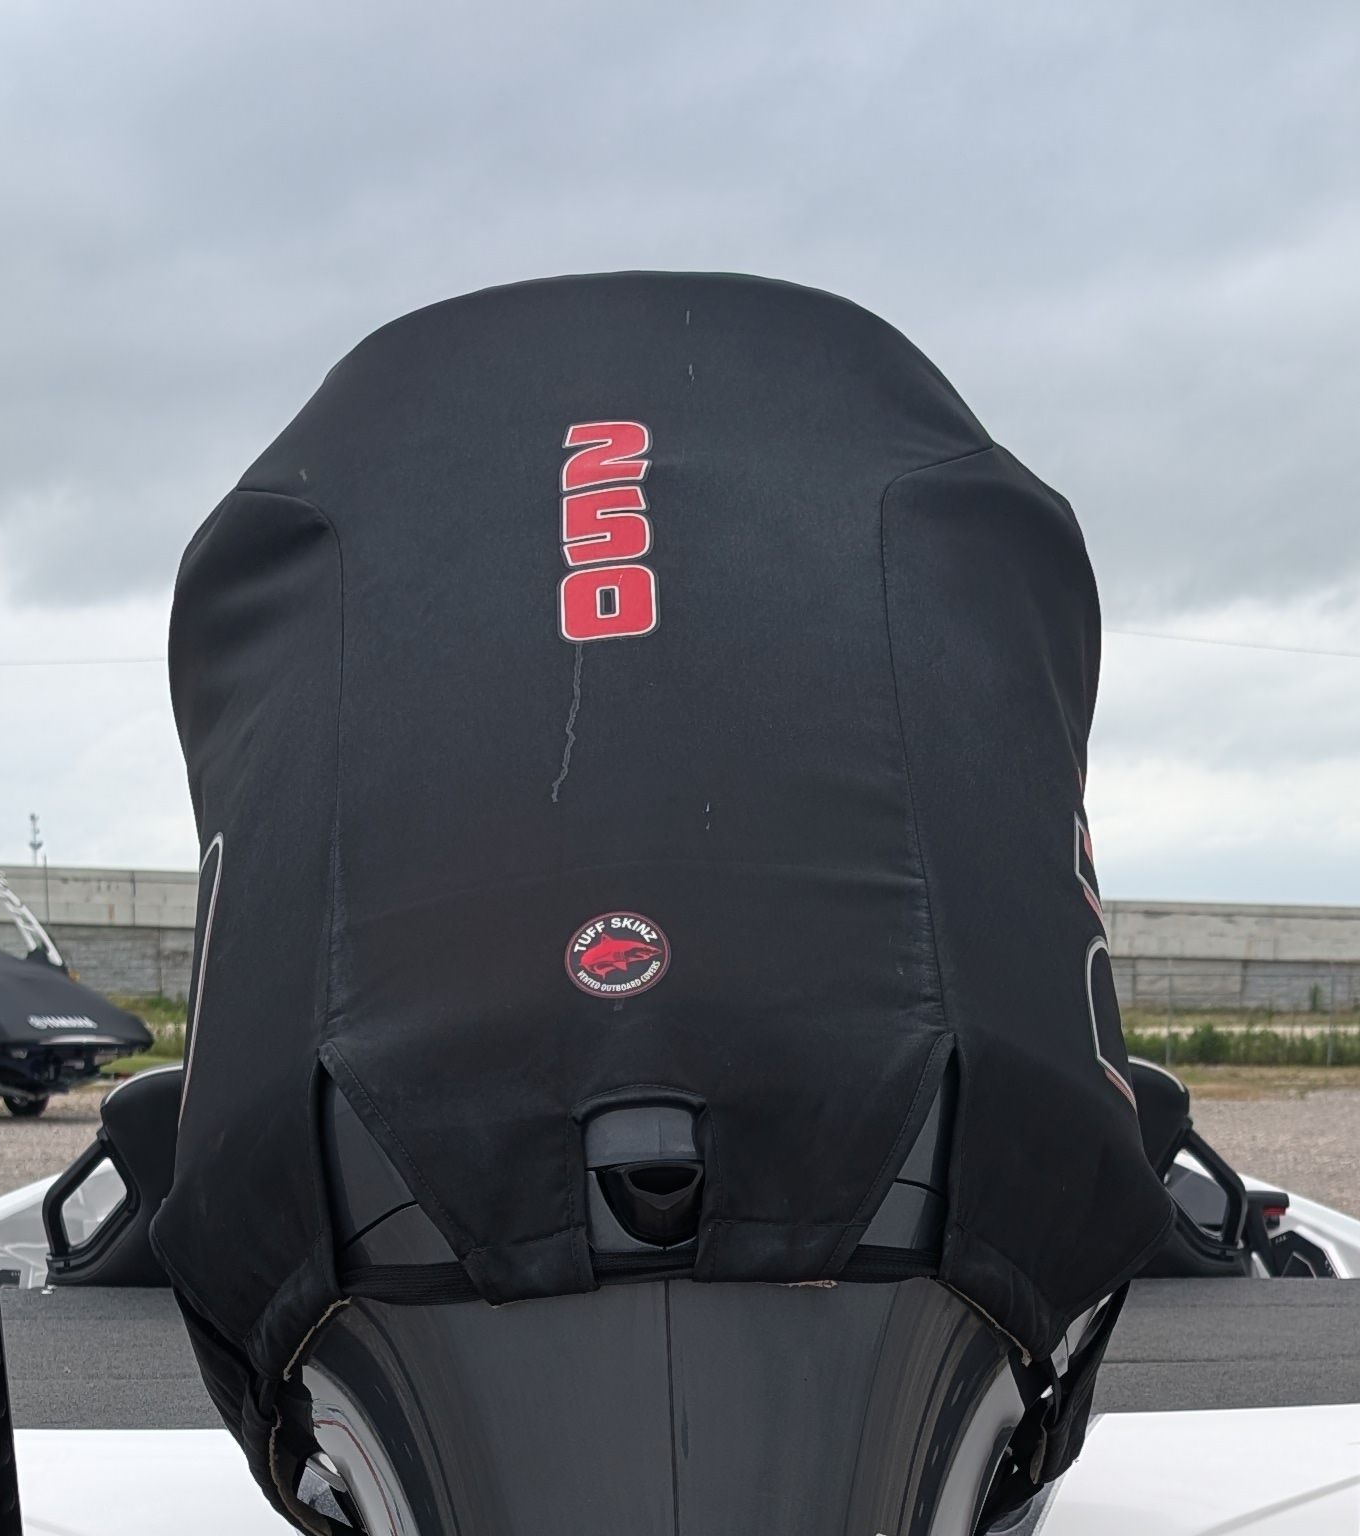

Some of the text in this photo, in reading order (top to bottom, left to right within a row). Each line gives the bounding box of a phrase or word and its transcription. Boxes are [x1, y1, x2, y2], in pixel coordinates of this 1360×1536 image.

[560, 421, 658, 642] 250
[573, 917, 658, 953] TUFF SKINZ
[576, 960, 661, 992] VENTED OUTBOARD COVERS
